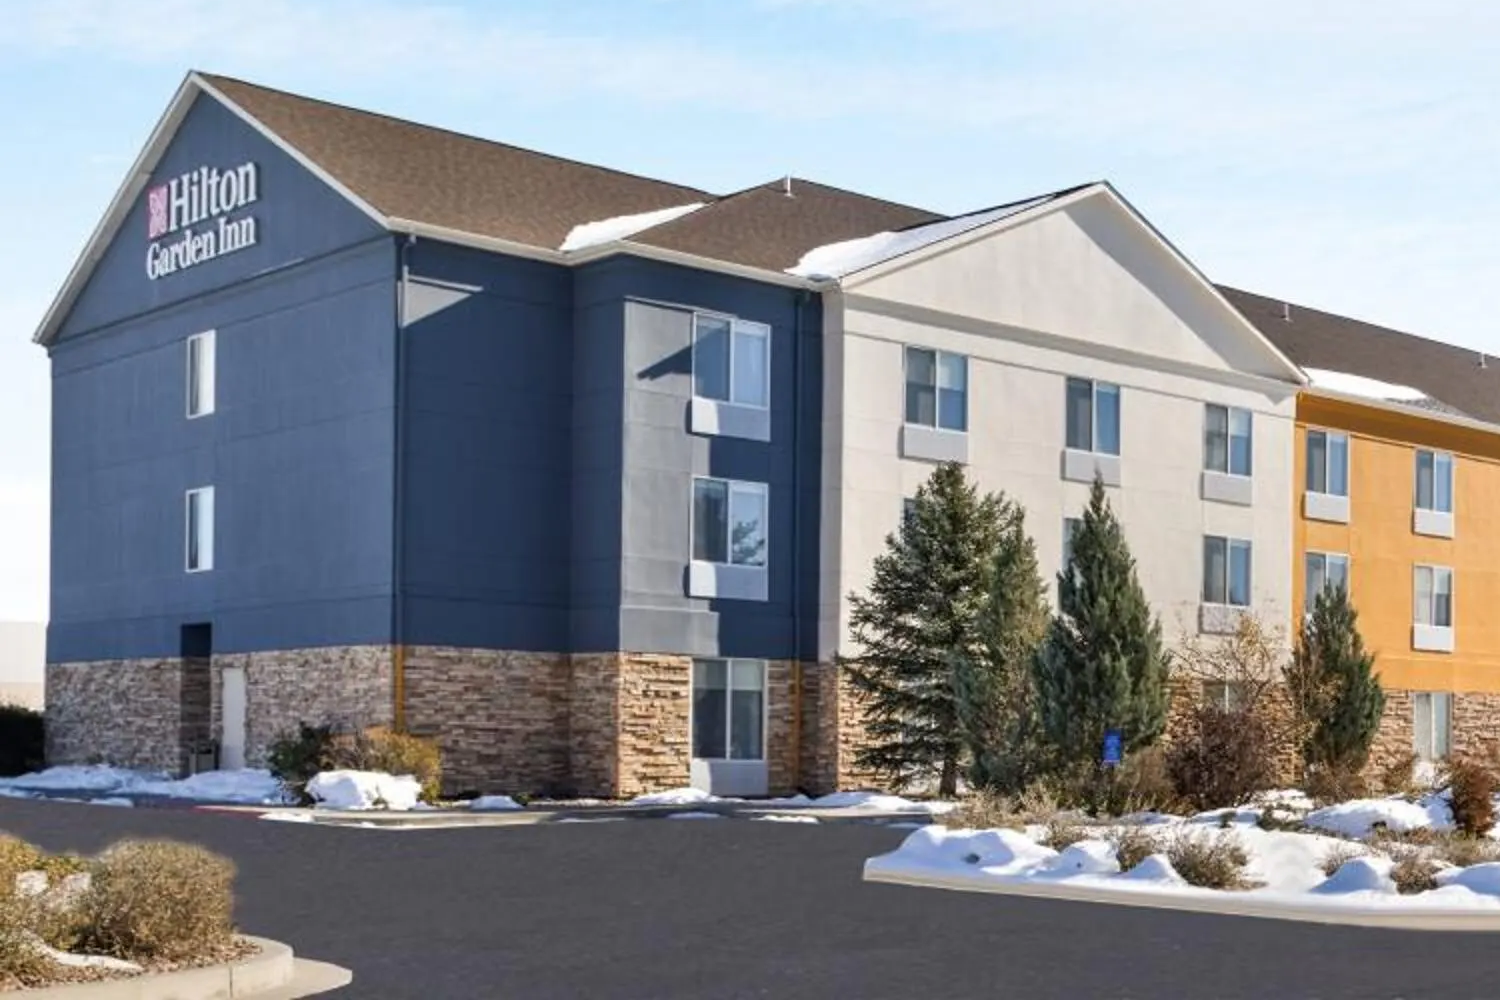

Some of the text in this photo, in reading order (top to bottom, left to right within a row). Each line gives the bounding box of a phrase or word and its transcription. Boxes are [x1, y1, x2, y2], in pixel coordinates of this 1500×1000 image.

[169, 162, 257, 232] Hilton
[147, 216, 256, 280] Garden Inn
